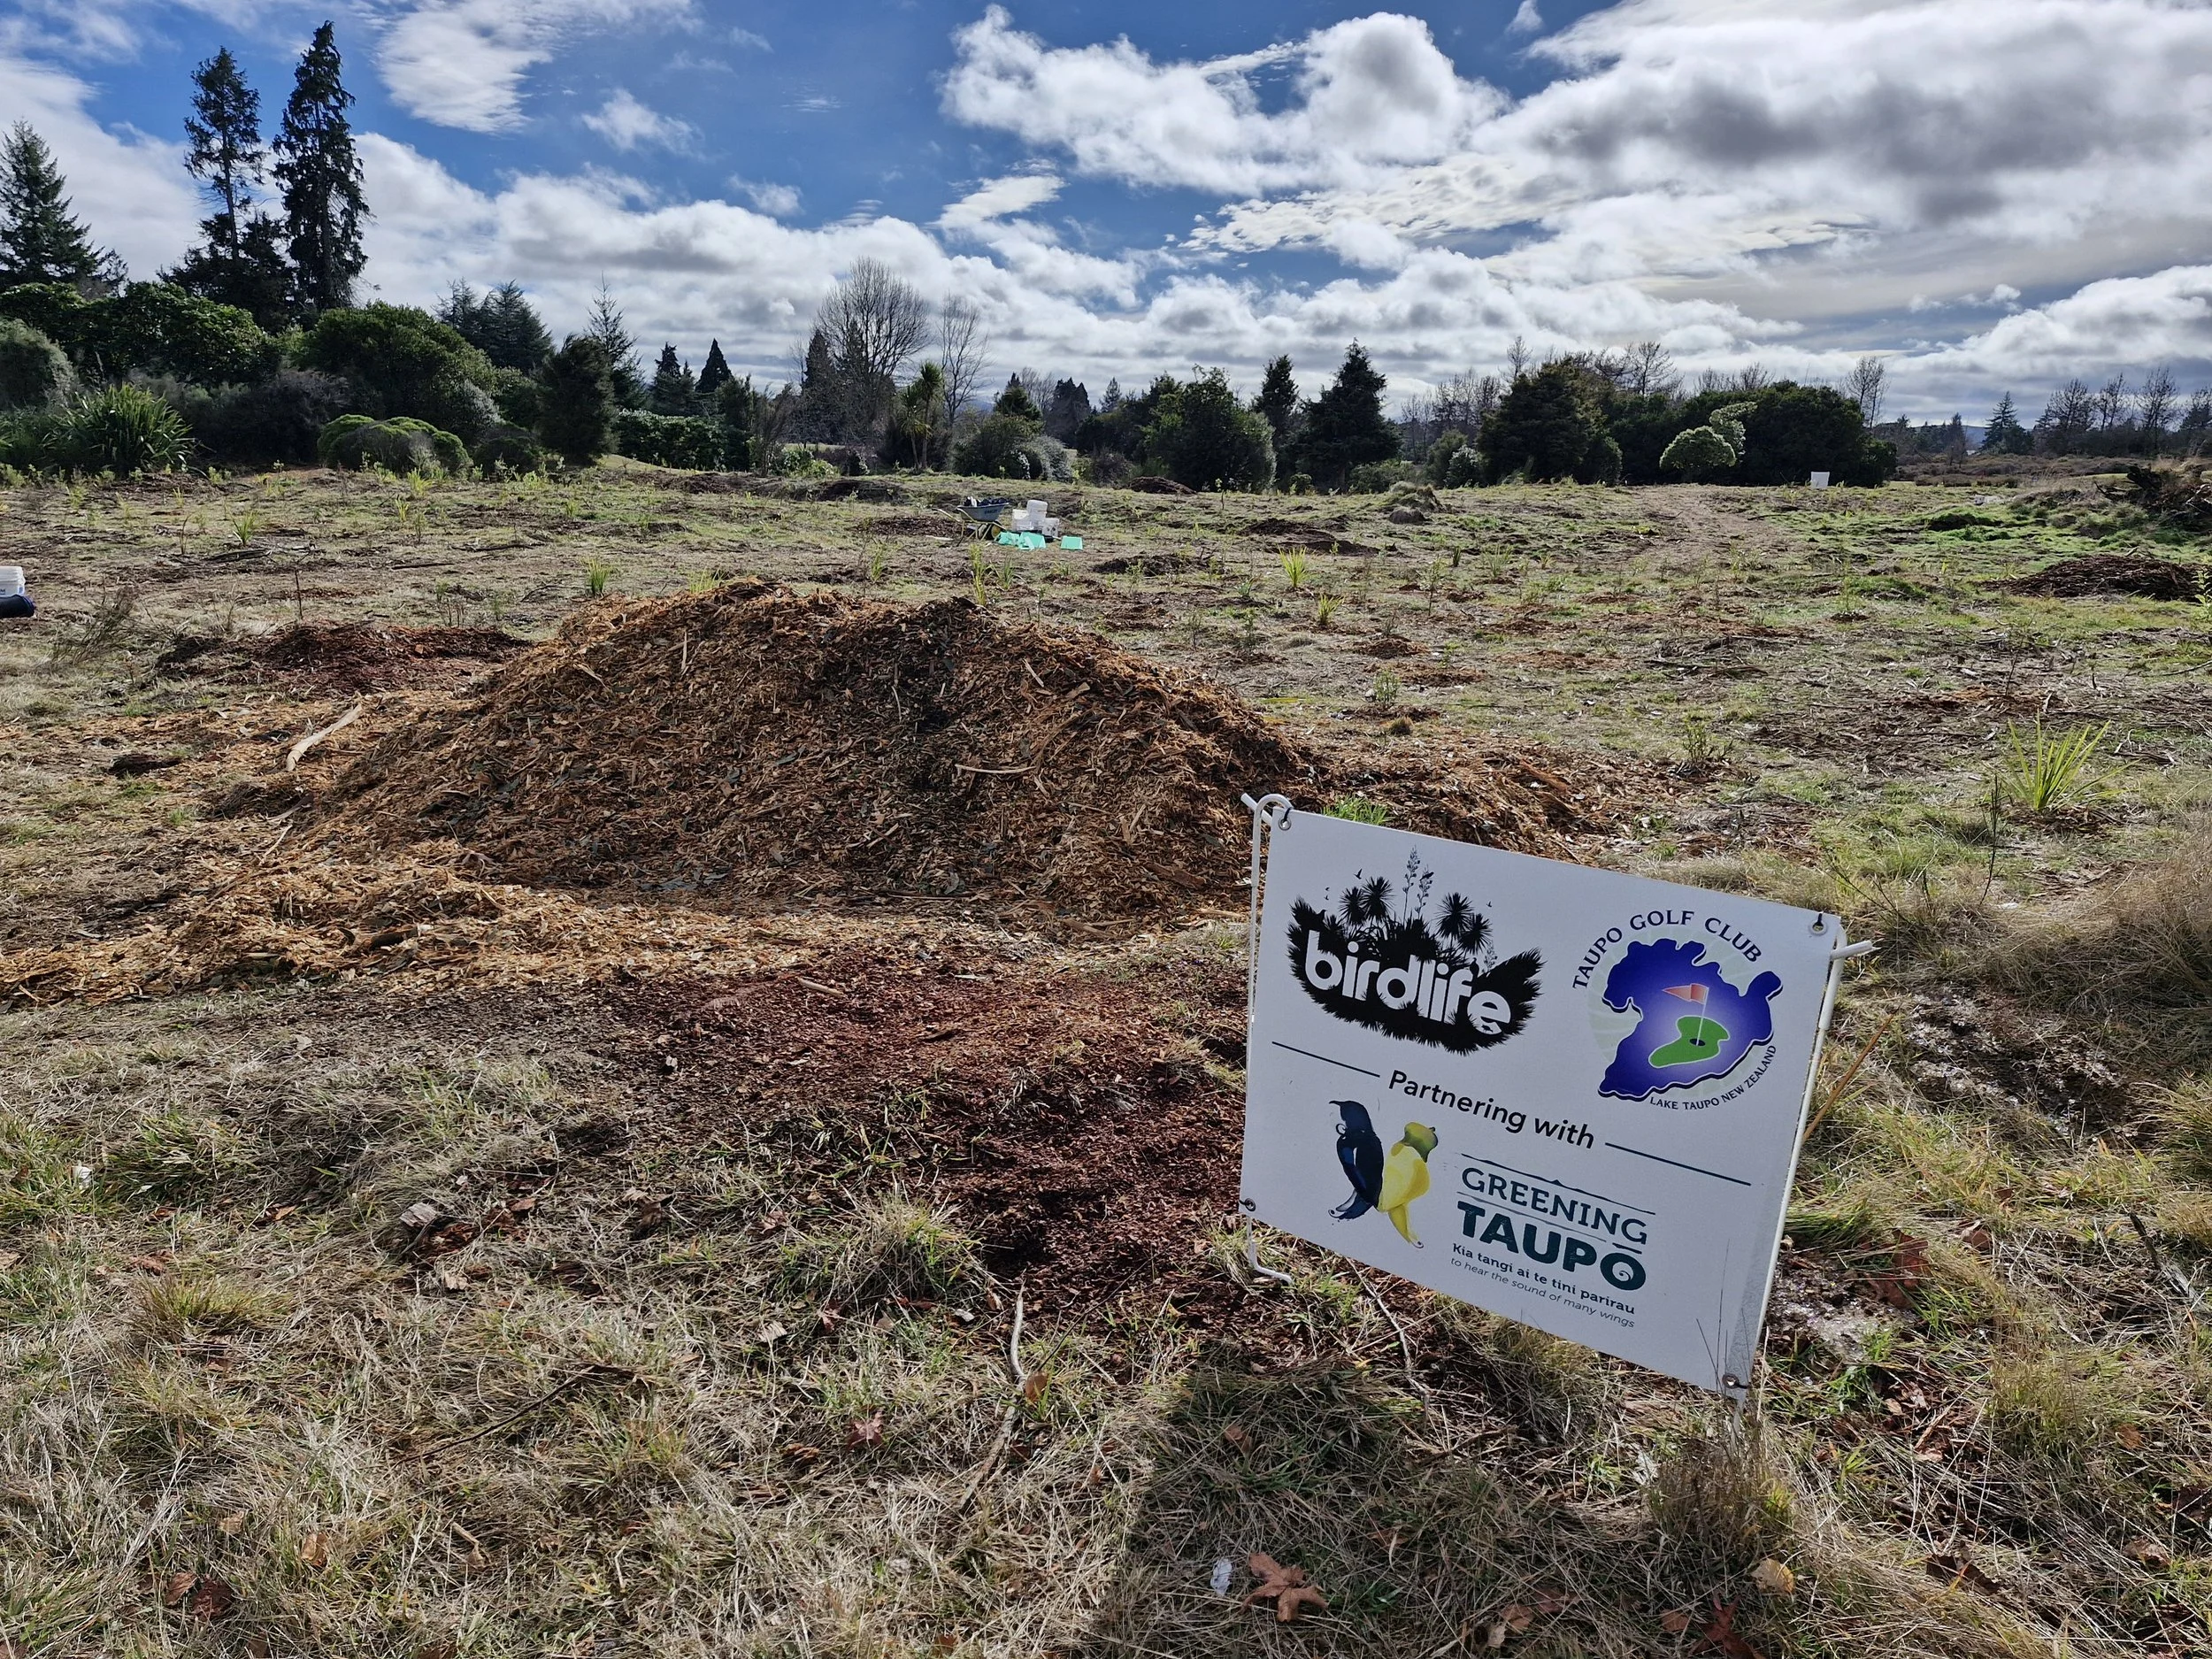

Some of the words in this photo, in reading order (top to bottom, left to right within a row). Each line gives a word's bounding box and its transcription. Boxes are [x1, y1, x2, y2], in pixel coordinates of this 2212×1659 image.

[1305, 929, 1510, 1034] birdlife
[1572, 927, 1623, 989] TAUPO
[1630, 910, 1694, 930] GOLF
[1704, 918, 1762, 963] CLUB
[1388, 1070, 1526, 1133] Partnering
[1534, 1118, 1594, 1149] with
[1650, 1097, 1678, 1110] LAKE
[1682, 1097, 1719, 1110] TAUPO
[1721, 1085, 1745, 1102] NEW
[1744, 1045, 1777, 1088] ZEALAND
[1462, 1167, 1647, 1245] GREENING
[1453, 1243, 1473, 1258] Kia
[1478, 1253, 1513, 1272] tangi
[1517, 1268, 1529, 1279] ai
[1534, 1272, 1548, 1284] te
[1552, 1279, 1576, 1294] tini
[1580, 1290, 1634, 1314] parirau
[1464, 1263, 1488, 1276] hear
[1491, 1272, 1509, 1284] the
[1511, 1280, 1547, 1297] sound
[1563, 1299, 1597, 1316] many
[1600, 1311, 1635, 1328] wings
